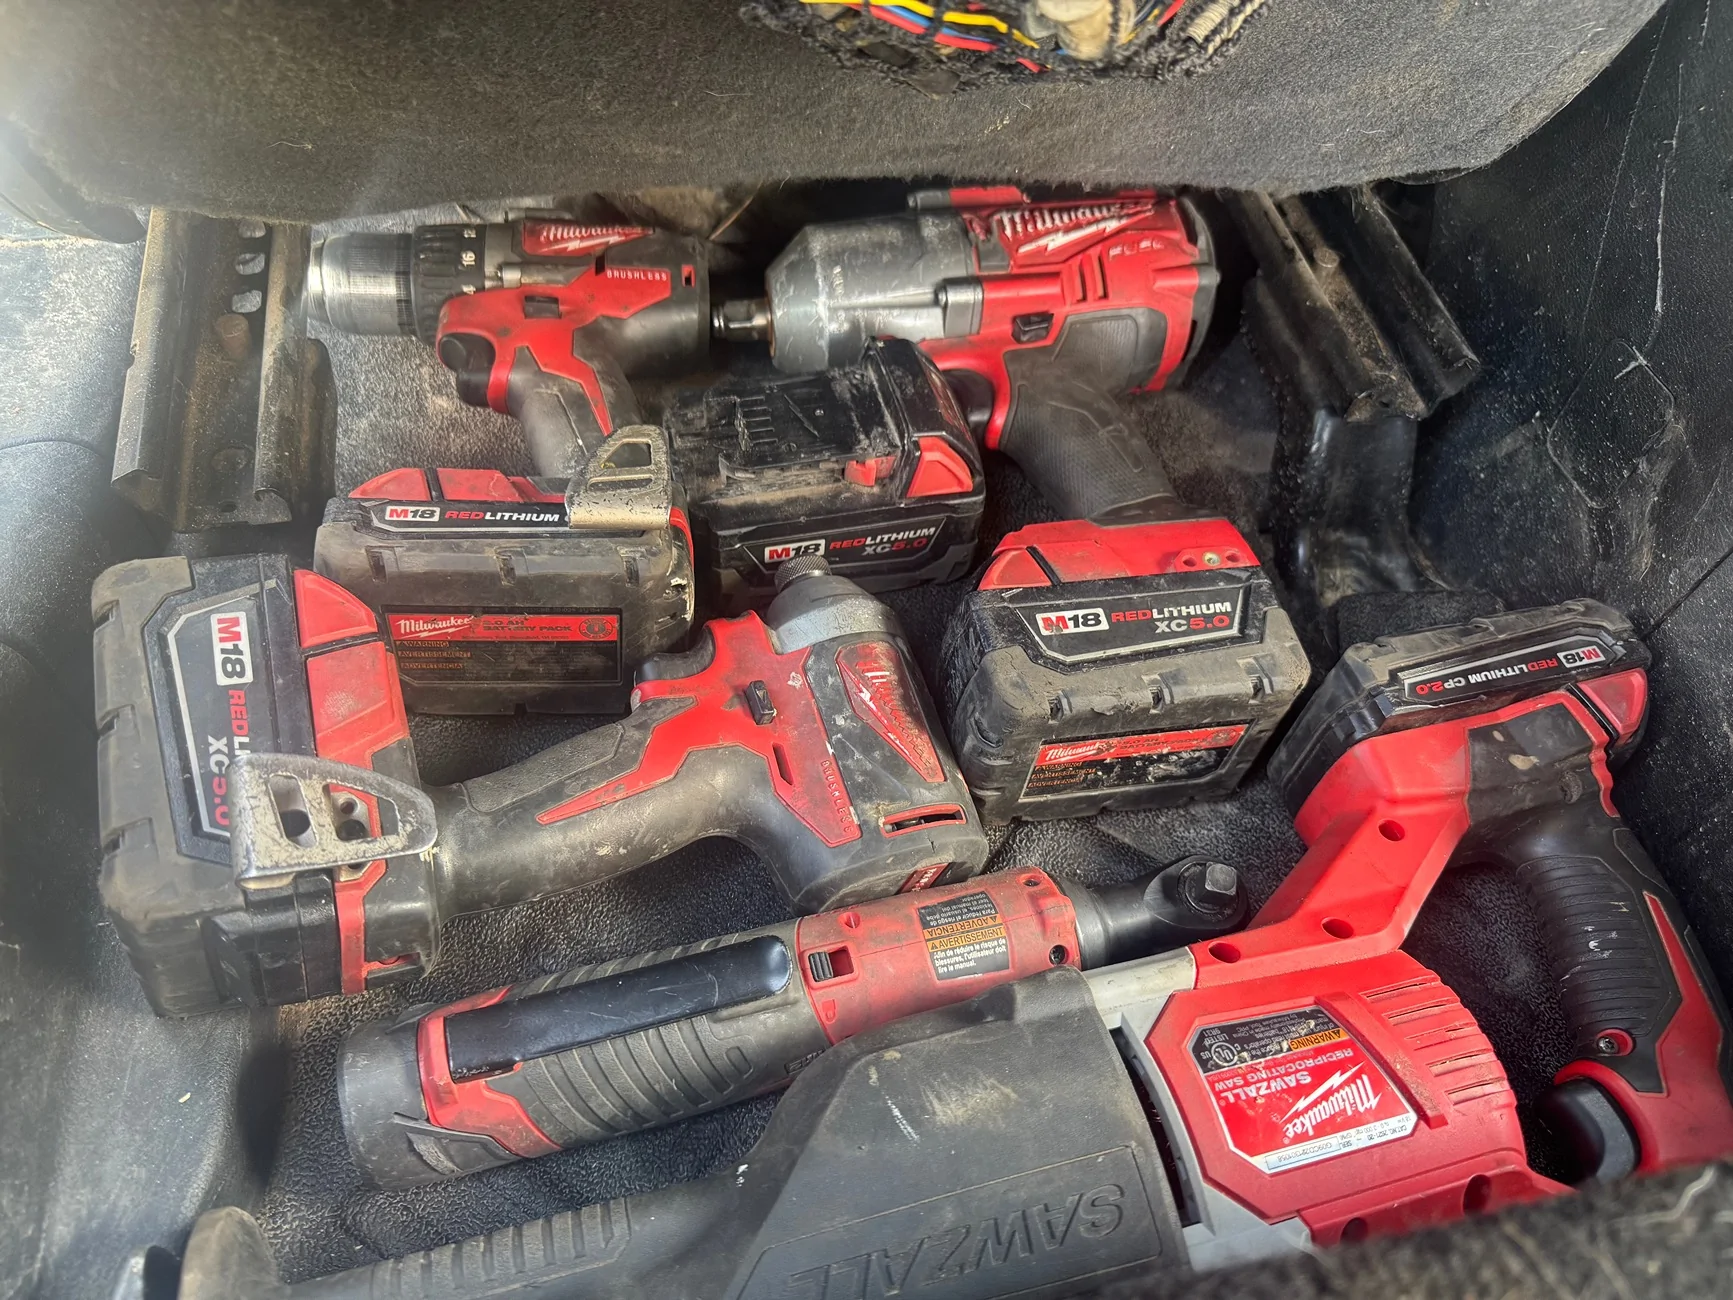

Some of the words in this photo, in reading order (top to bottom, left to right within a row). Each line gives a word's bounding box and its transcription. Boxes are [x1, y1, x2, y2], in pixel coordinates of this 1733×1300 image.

[461, 250, 476, 267] 16
[606, 268, 668, 281] BRUSHLESS
[388, 507, 437, 520] M18
[444, 509, 560, 522] REDLITHIUM
[767, 541, 823, 560] M18
[829, 526, 936, 550] REDLITHIUM
[861, 537, 927, 556] XC5.0
[394, 615, 475, 634] Milwaukee
[1039, 612, 1102, 634] M18
[1110, 601, 1232, 623] REDLITHIUM
[1154, 615, 1230, 634] XC5.0
[215, 615, 246, 680] M18
[1564, 646, 1603, 666] M18
[1468, 657, 1559, 685] REDLITHIUM
[1416, 676, 1466, 695] CP2.0
[229, 690, 250, 756] REDLI
[208, 735, 230, 826] XC5.0
[821, 760, 853, 833] BRUSHLESS
[927, 917, 988, 937] ADVERTENCIA
[939, 927, 1003, 949] AVERTISSEMENT
[980, 940, 998, 949] risque
[935, 956, 964, 967] blessures,
[1291, 1031, 1335, 1050] WARNING
[1200, 1051, 1211, 1060] US
[1216, 1047, 1233, 1060] UL
[1247, 1047, 1354, 1083] RECIPROCATING
[1214, 1077, 1245, 1091] SAW
[1219, 1070, 1313, 1103] SAWZALL
[1282, 1073, 1384, 1137] Milwaukee
[790, 1183, 1126, 1299] SAWZALL
